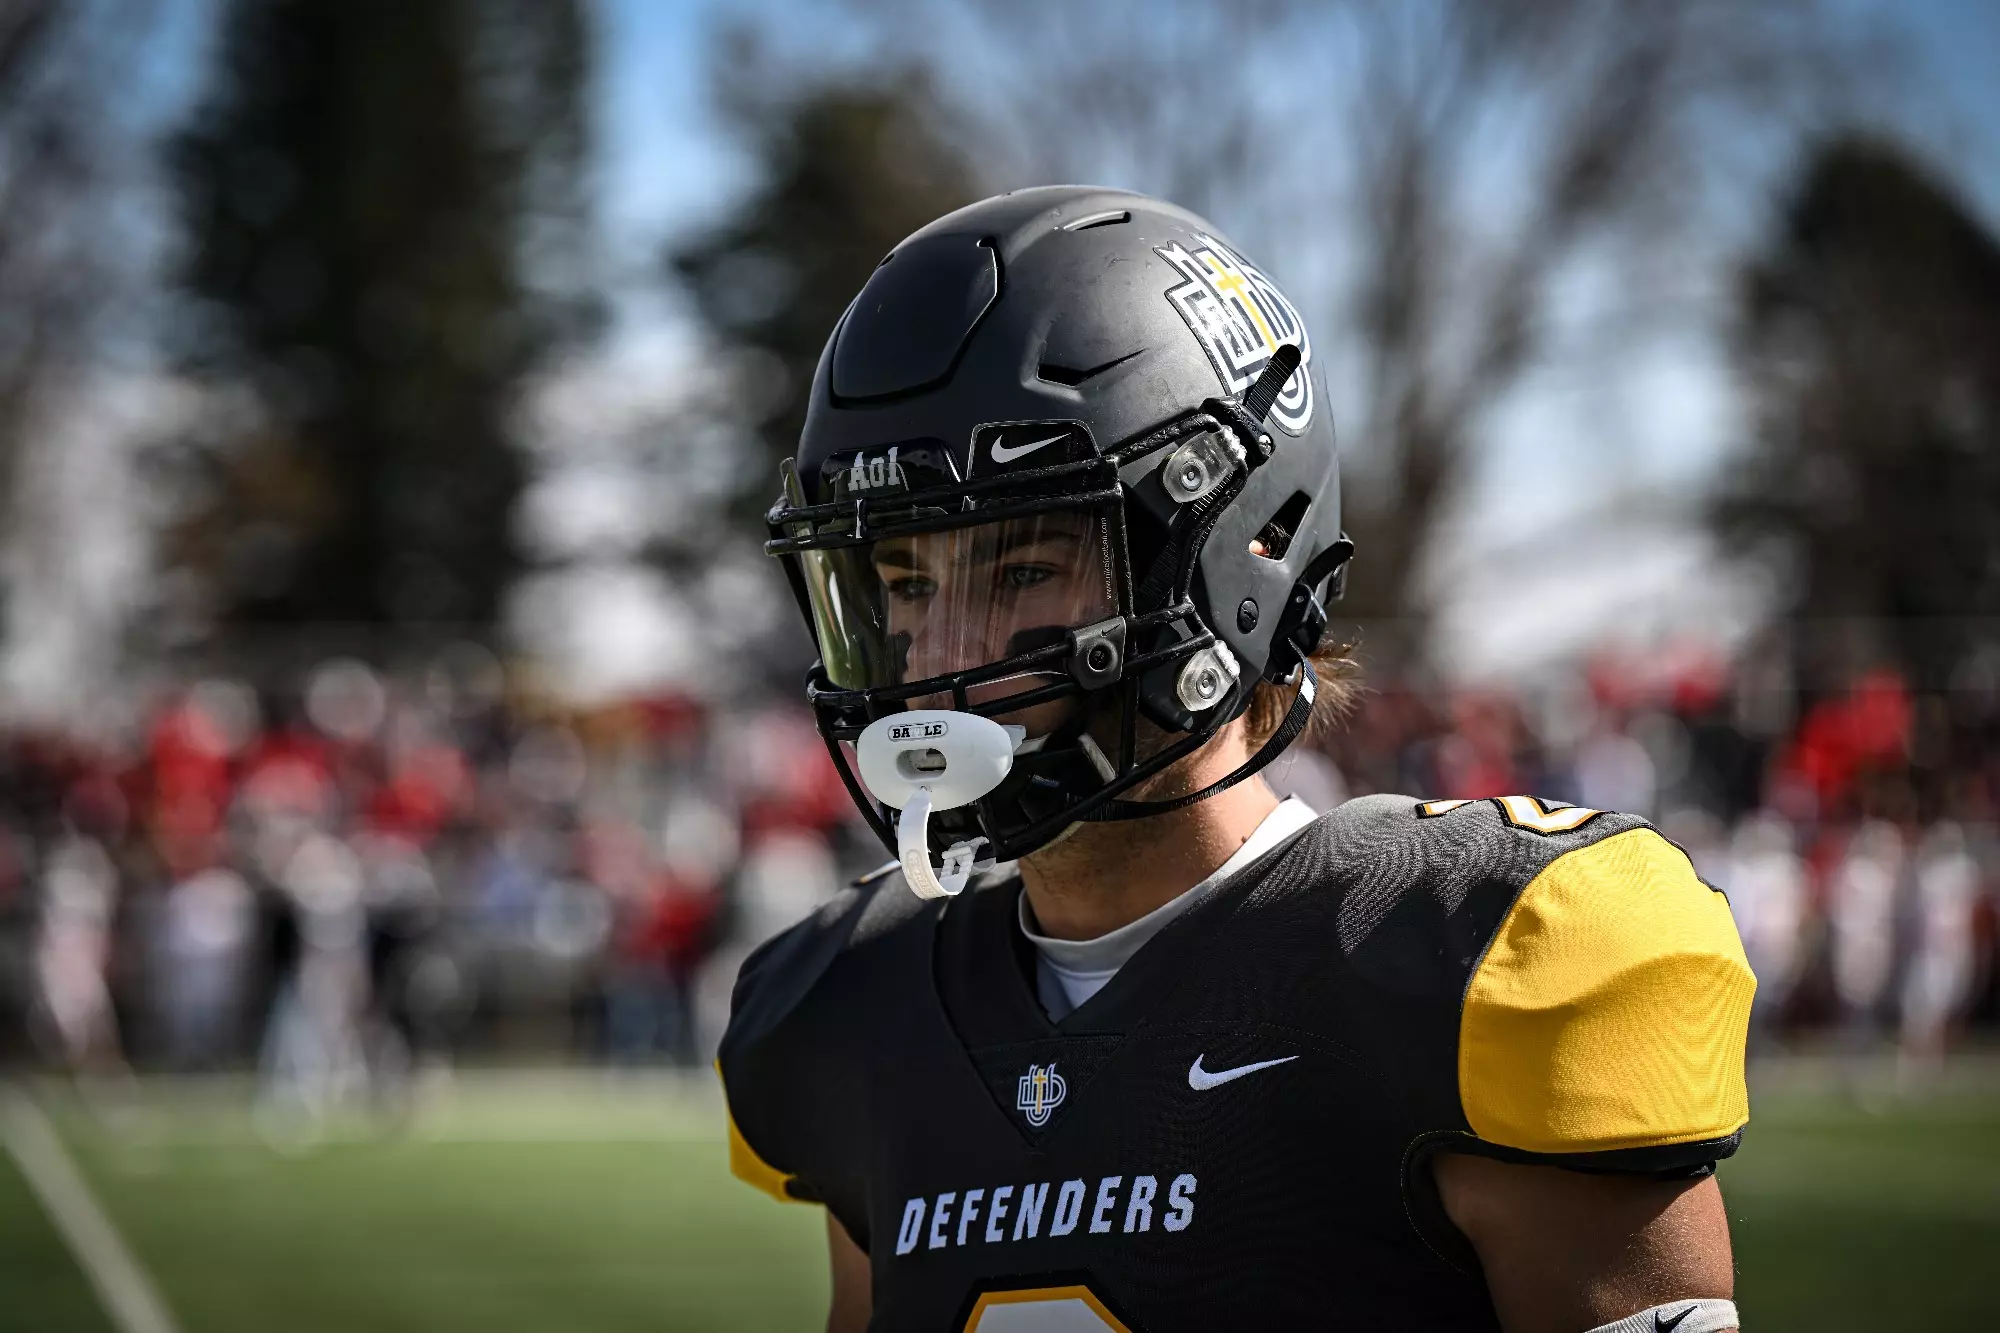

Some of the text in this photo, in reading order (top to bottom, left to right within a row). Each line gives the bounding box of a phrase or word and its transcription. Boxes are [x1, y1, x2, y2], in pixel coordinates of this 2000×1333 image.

[1101, 517, 1112, 600] www.nikefootball.com
[892, 724, 942, 739] BALE
[895, 1173, 1198, 1256] DEFENDERS
